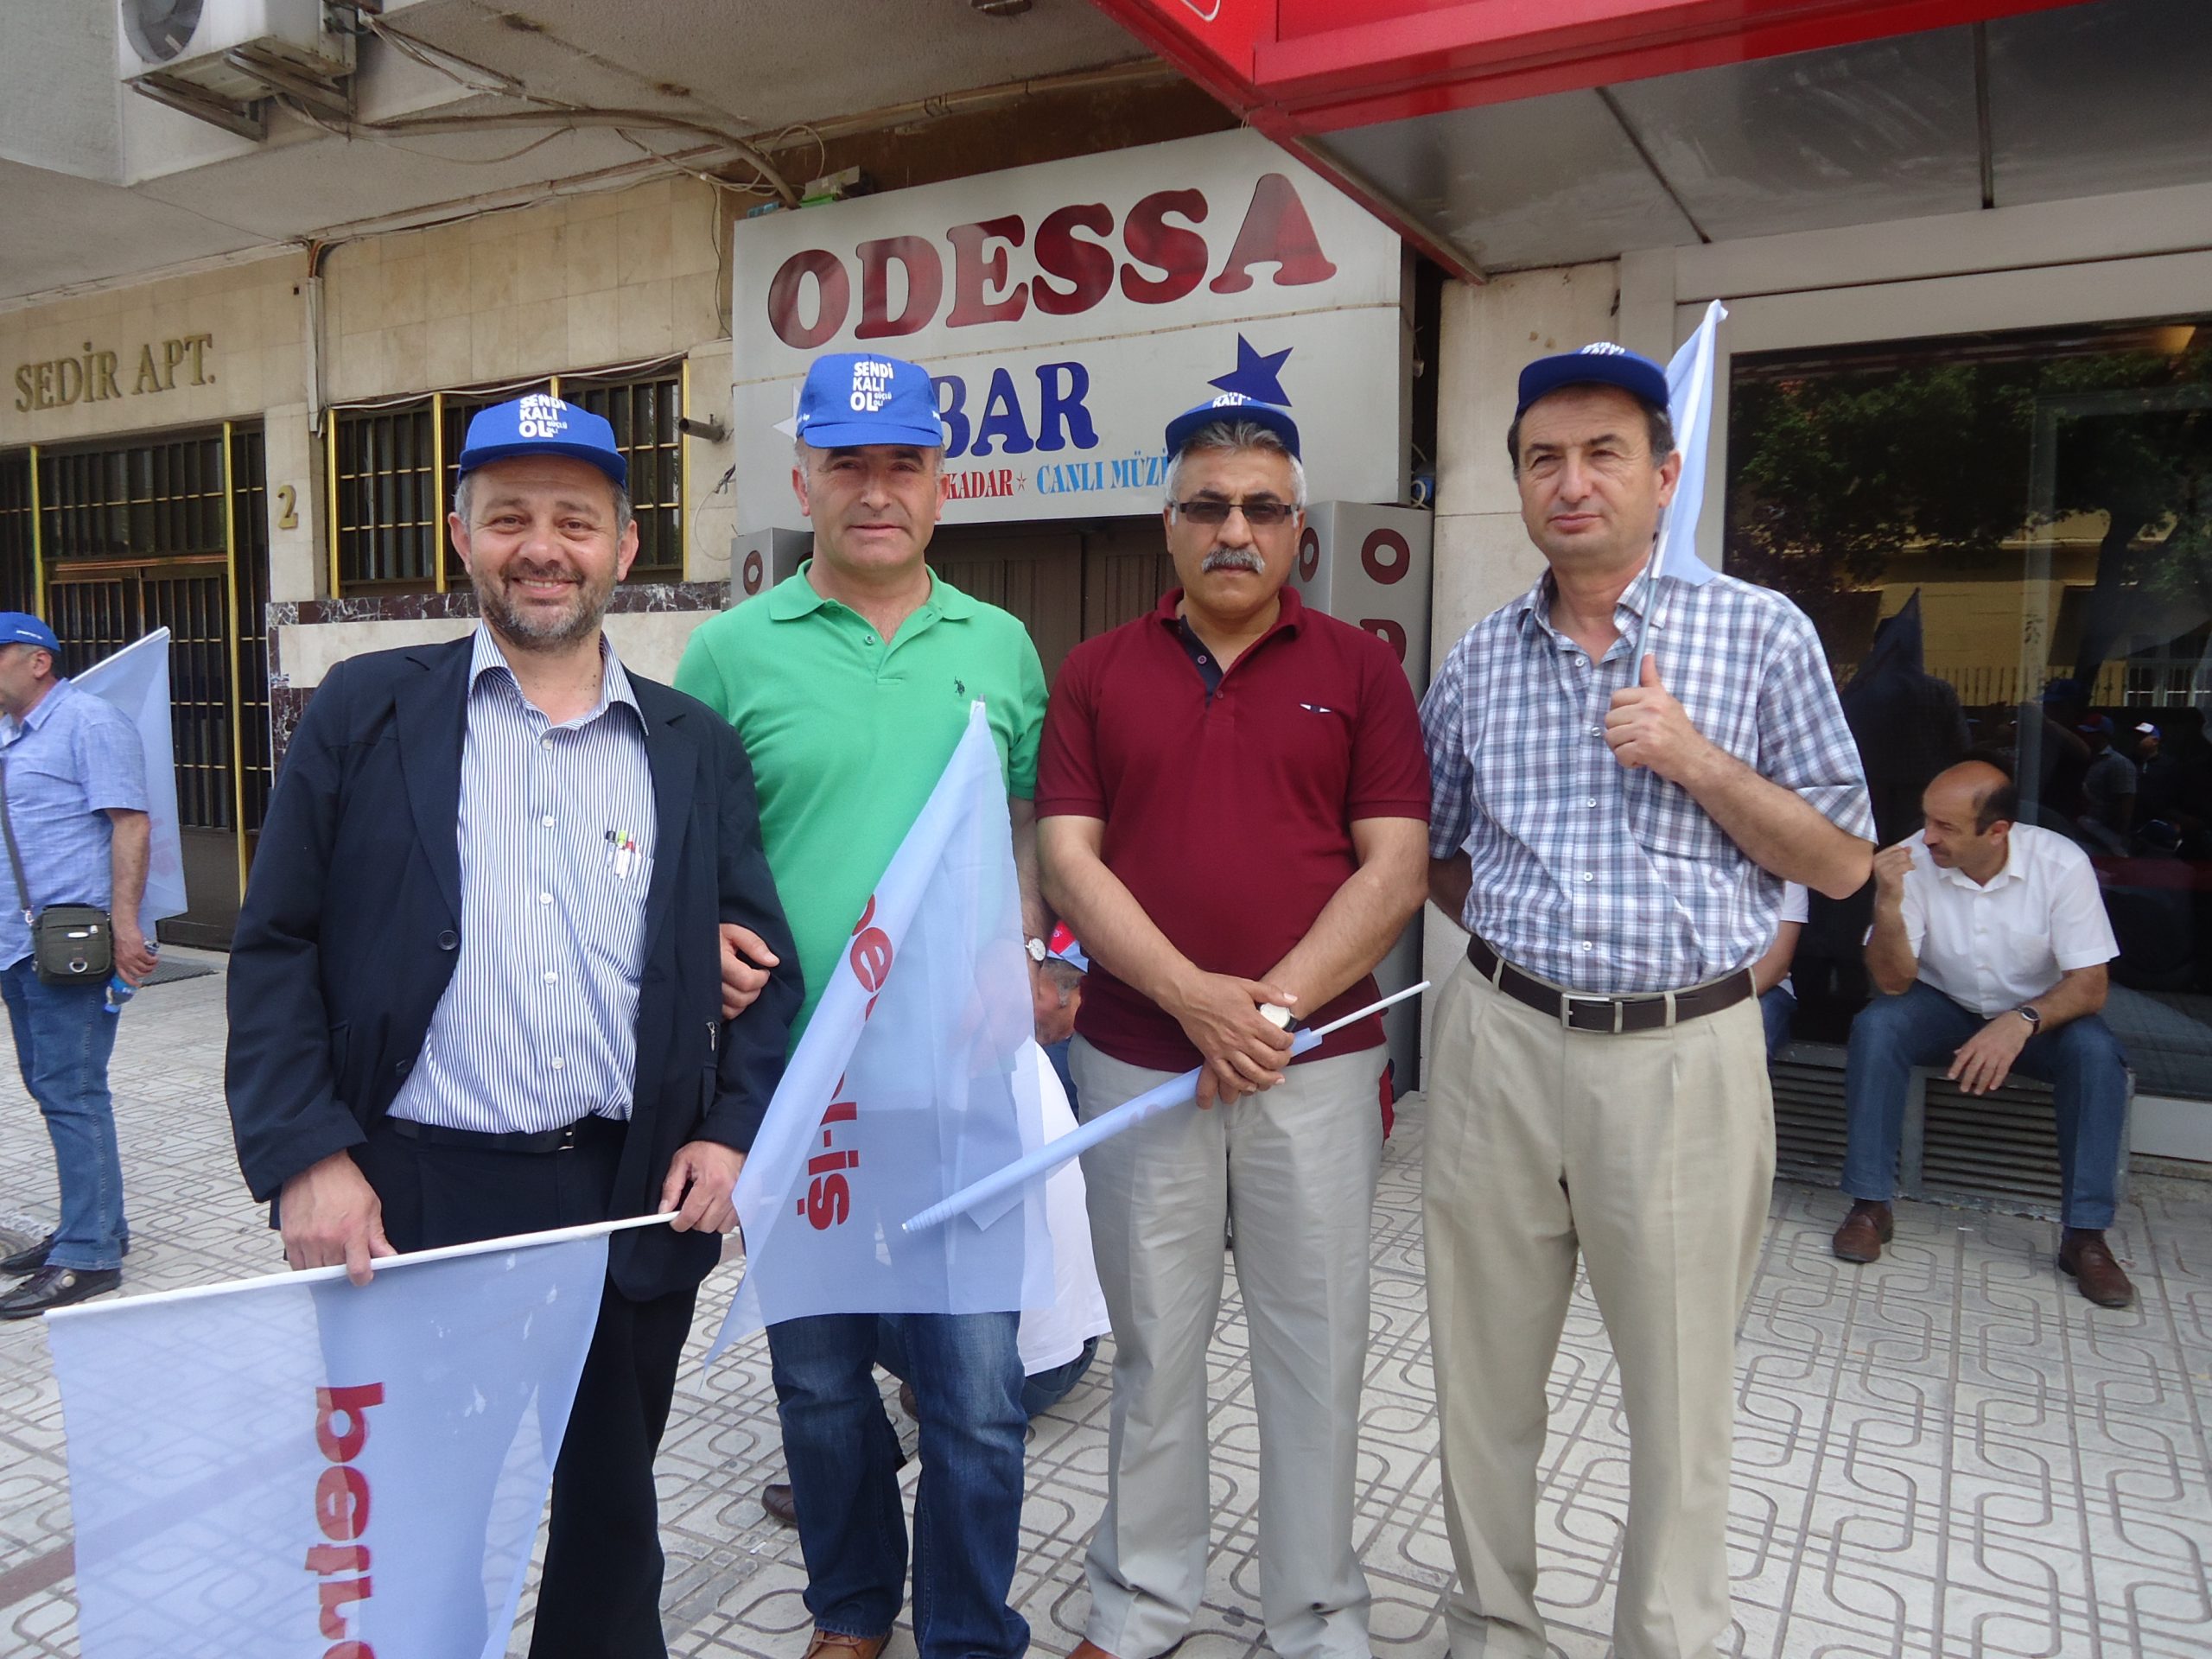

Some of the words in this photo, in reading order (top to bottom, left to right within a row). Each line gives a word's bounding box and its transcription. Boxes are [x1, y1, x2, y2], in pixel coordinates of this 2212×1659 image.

[767, 173, 1338, 349] ODESSA
[15, 341, 122, 413] SEDİR
[131, 334, 215, 395] APT.
[853, 378, 884, 391] KALI
[519, 407, 558, 421] KALI
[850, 391, 878, 411] OL
[930, 361, 1099, 459] BAR
[519, 420, 554, 438] OL
[947, 469, 1014, 500] KADAR
[1037, 461, 1103, 495] CANLI
[277, 485, 298, 530] 2
